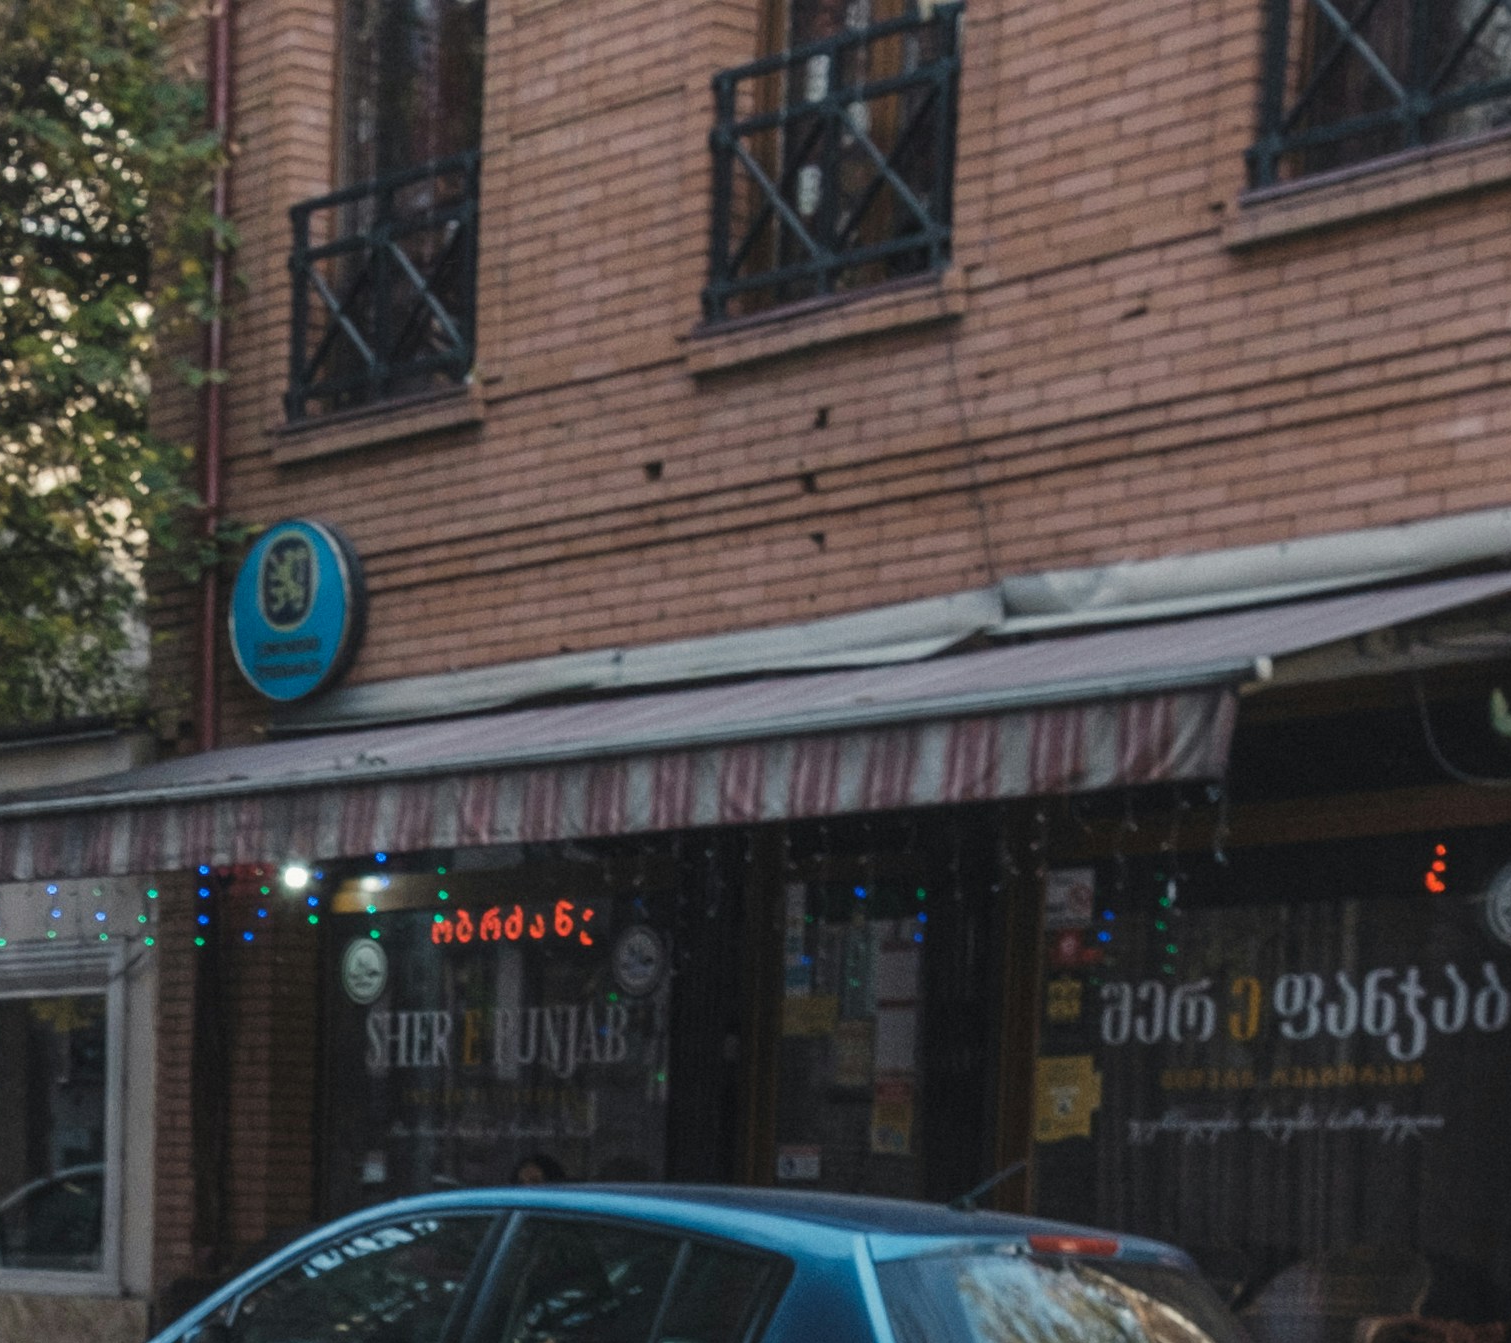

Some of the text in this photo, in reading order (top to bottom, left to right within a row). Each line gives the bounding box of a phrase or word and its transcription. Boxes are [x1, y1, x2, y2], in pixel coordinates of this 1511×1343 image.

[367, 1004, 628, 1078] SHER E PUNJAB
